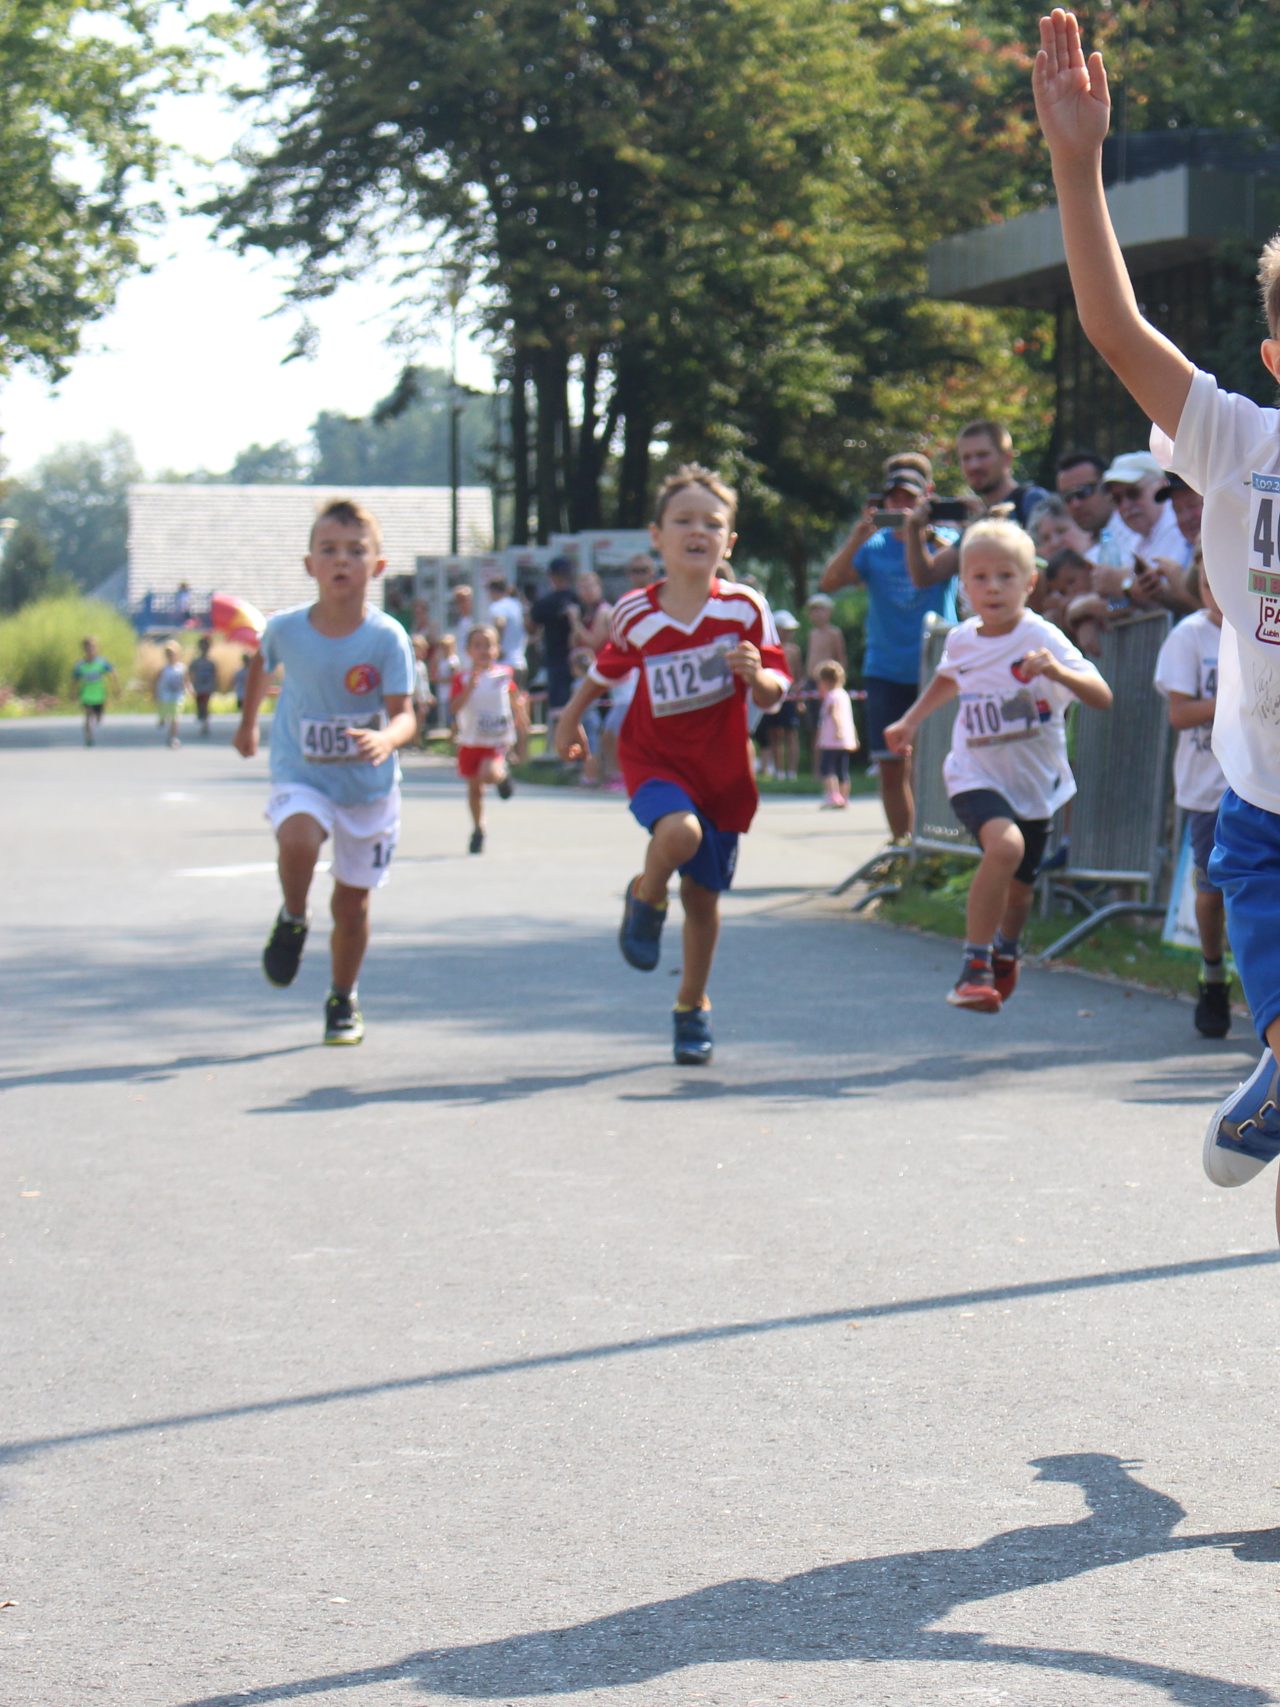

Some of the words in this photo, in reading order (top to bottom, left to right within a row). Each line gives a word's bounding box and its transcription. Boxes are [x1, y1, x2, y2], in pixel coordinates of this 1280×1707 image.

[653, 662, 699, 700] 412
[965, 701, 1001, 735] 410
[304, 723, 349, 754] 405
